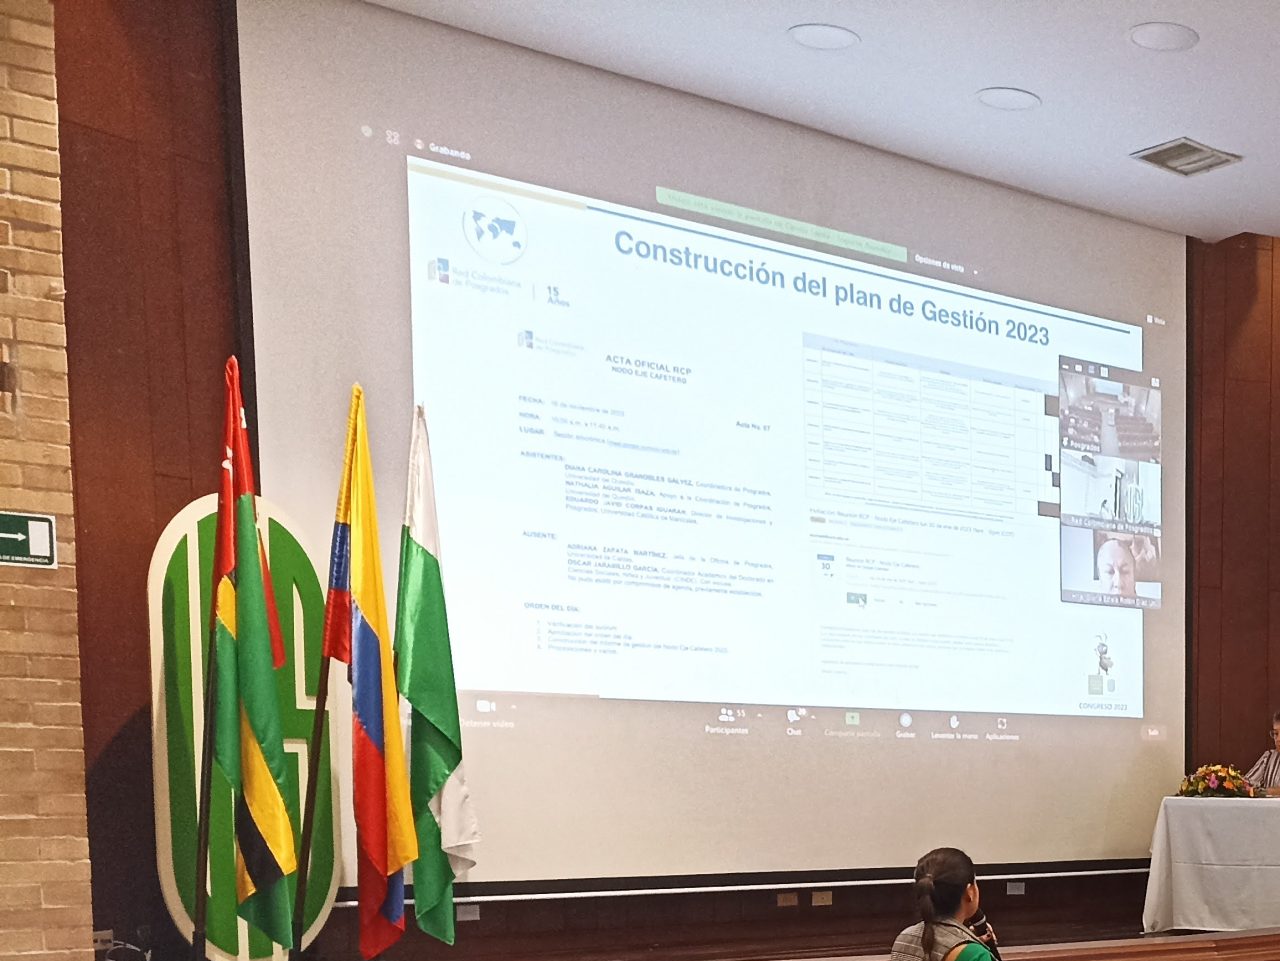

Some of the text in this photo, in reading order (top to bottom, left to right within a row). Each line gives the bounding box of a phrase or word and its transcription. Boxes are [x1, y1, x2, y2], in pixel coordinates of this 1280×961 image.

[547, 285, 560, 296] 15
[615, 230, 785, 289] Construcción
[793, 272, 826, 298] del
[834, 282, 881, 309] plan
[890, 293, 914, 316] de
[921, 300, 999, 335] Gestión
[1006, 320, 1050, 346] 2023
[606, 354, 692, 376] ACTA OFICIAL RCP
[611, 366, 687, 384] NODO EJE CAFETERO
